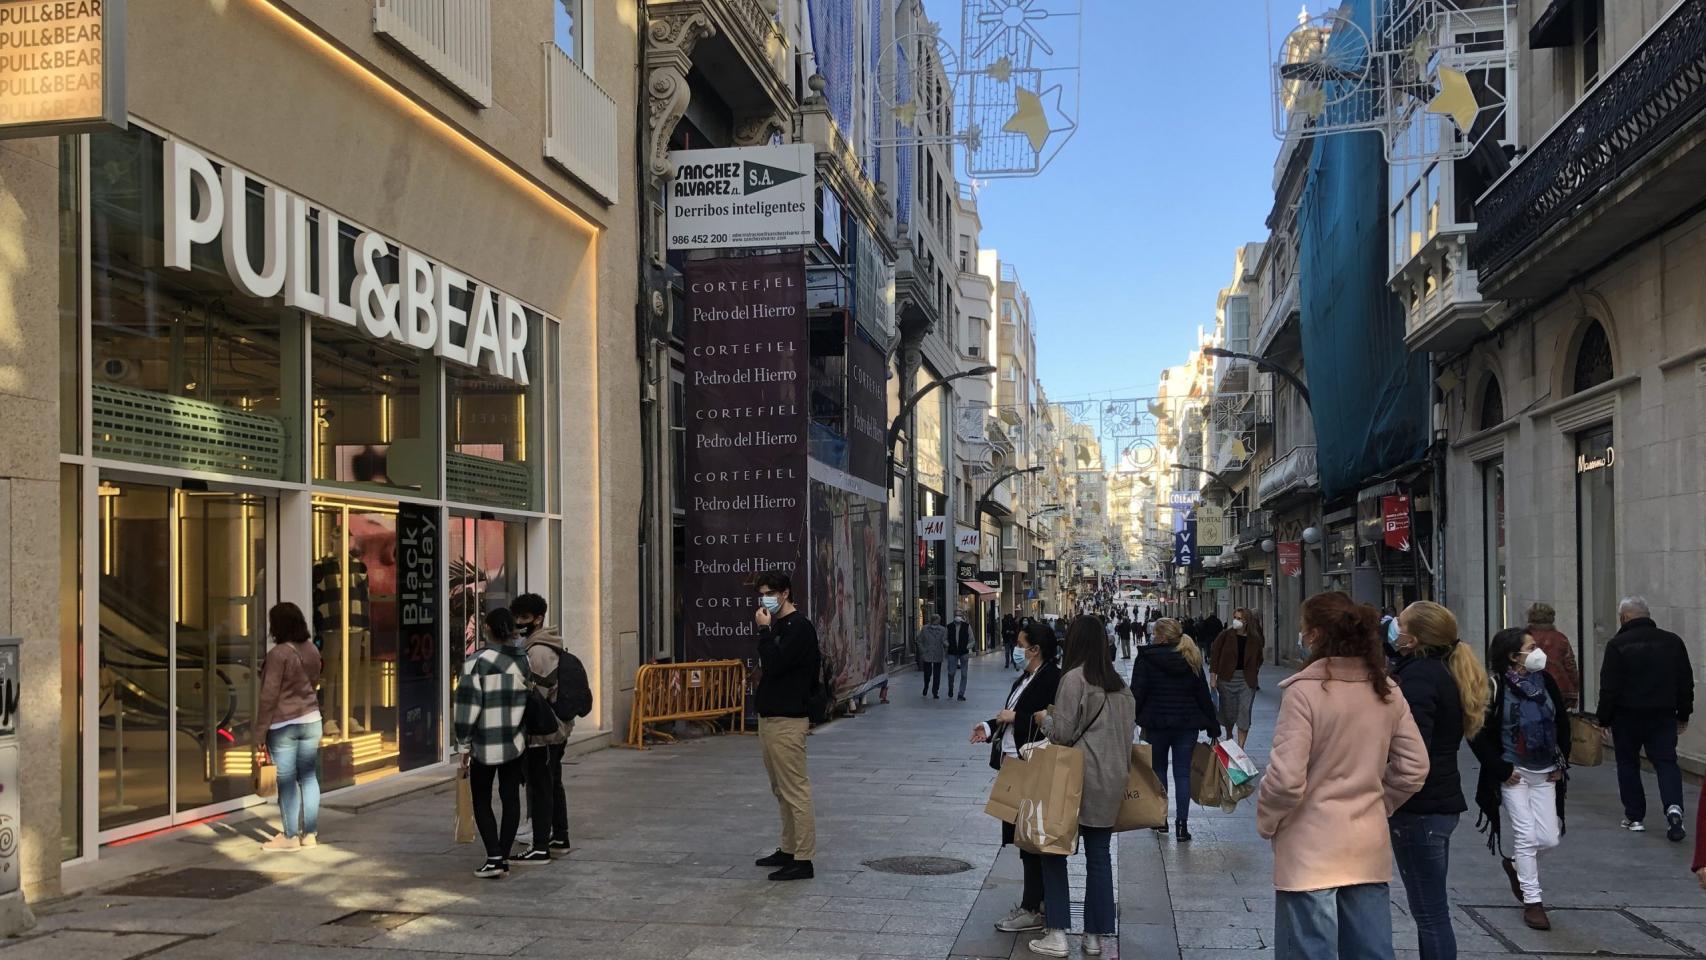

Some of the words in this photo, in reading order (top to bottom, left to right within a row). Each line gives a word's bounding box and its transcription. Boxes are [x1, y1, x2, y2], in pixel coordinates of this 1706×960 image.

[0, 0, 101, 26] PULL&BEAR
[0, 24, 101, 50] PULL&BEAR
[0, 47, 101, 73] PULL&BEAR
[0, 72, 101, 97] PULL&BEAR
[675, 162, 740, 180] SANCHEZ
[749, 168, 774, 186] S.A.
[674, 180, 731, 197] ALVAREZ
[675, 203, 729, 218] Derribos
[732, 201, 806, 217] inteligentes
[672, 235, 689, 245] 986
[691, 234, 708, 244] 452
[711, 233, 728, 243] 200
[163, 139, 529, 386] PULL&BEAR
[691, 277, 795, 293] CORTEFIEL
[693, 307, 728, 322] Pedro
[731, 305, 749, 319] del
[752, 303, 796, 318] Hierro
[693, 341, 797, 357] CORTEFIEL
[694, 370, 730, 386] Pedro
[732, 368, 750, 383] del
[754, 367, 797, 382] Hierro
[696, 404, 798, 420] CORTEFIEL
[696, 434, 732, 449] Pedro
[734, 431, 752, 447] del
[755, 430, 797, 446] Hierro
[694, 468, 796, 483] CORTEFIEL
[694, 496, 730, 511] Pedro
[732, 495, 750, 510] del
[753, 494, 796, 509] Hierro
[924, 521, 944, 535] H&M
[694, 532, 796, 546] CORTEFIEL
[961, 535, 977, 546] H&M
[1180, 510, 1191, 565] VIVAS
[419, 515, 436, 624] Friday
[694, 559, 730, 574] Pedro
[733, 558, 750, 573] del
[754, 557, 796, 572] Hierro
[402, 527, 418, 625] Black
[697, 621, 733, 637] Pedro
[735, 620, 753, 636] del
